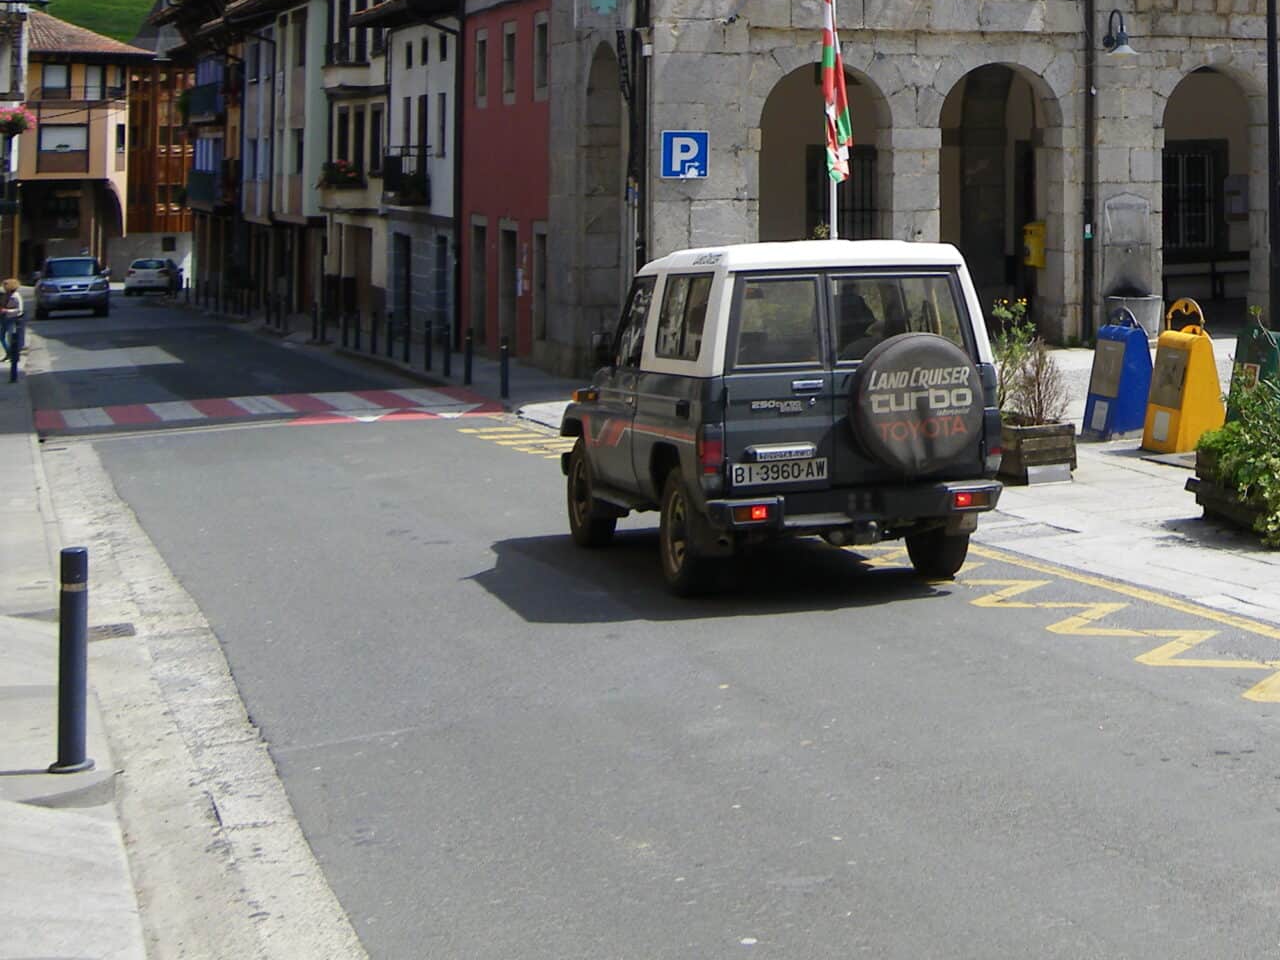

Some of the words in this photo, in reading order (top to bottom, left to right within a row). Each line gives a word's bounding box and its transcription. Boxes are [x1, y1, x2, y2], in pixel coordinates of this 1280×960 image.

[671, 136, 699, 172] P
[868, 370, 910, 391] LAND
[909, 366, 971, 389] CRUISER
[878, 415, 969, 443] TOYOTA
